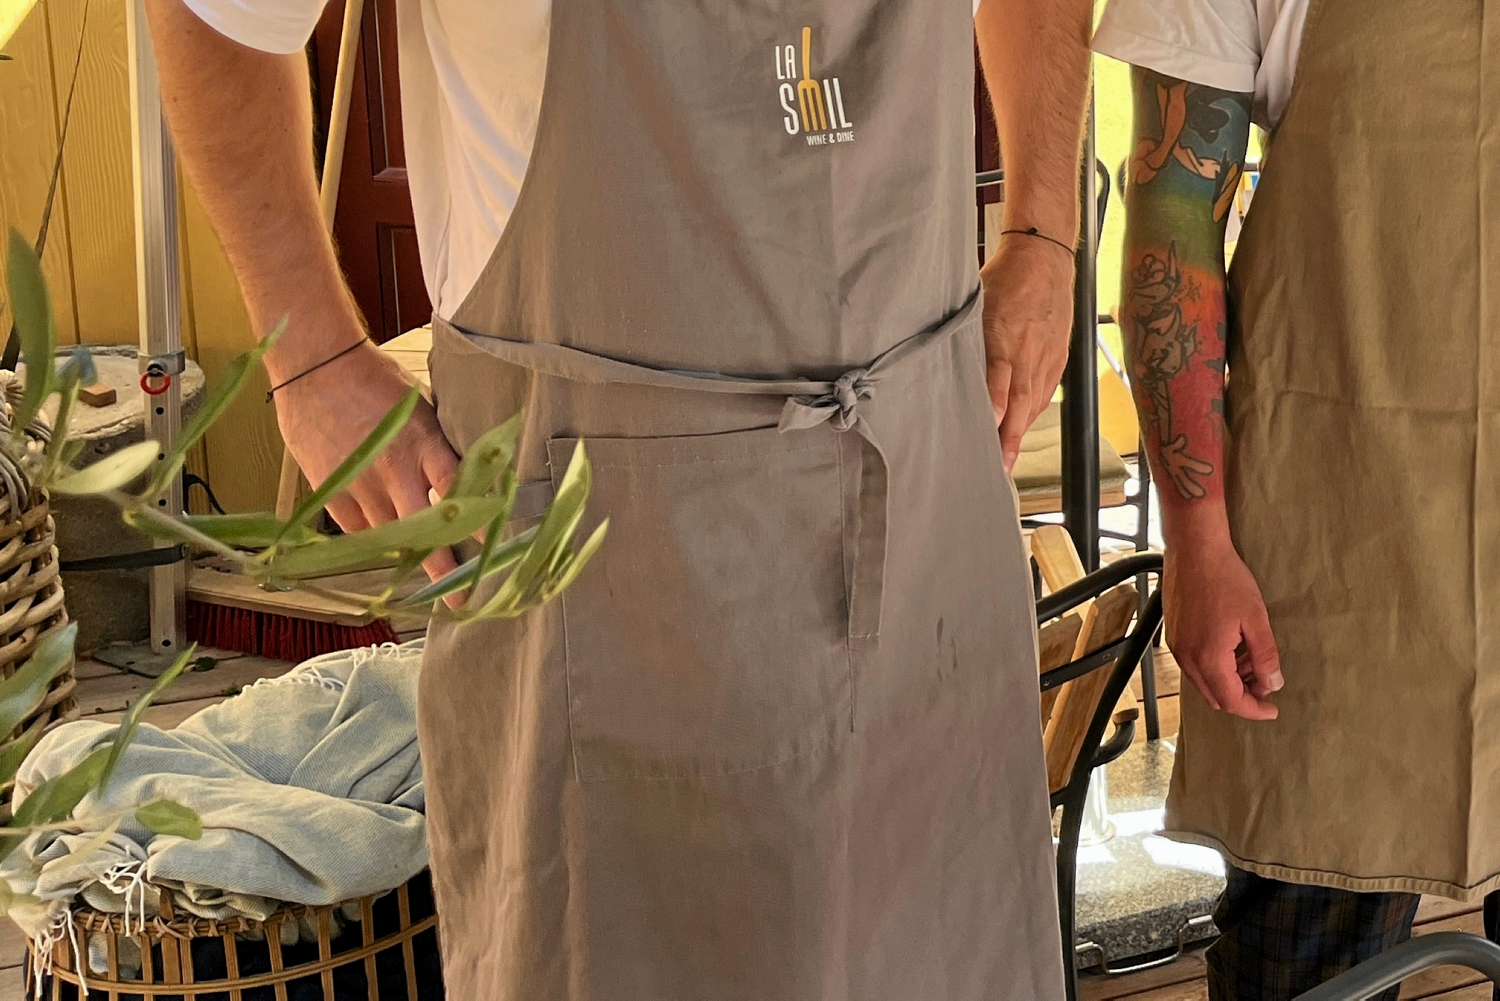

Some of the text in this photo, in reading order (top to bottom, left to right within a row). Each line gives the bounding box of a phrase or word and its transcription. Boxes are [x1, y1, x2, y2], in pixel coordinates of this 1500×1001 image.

[775, 44, 797, 80] LA
[806, 131, 855, 147] WINE & DINE
